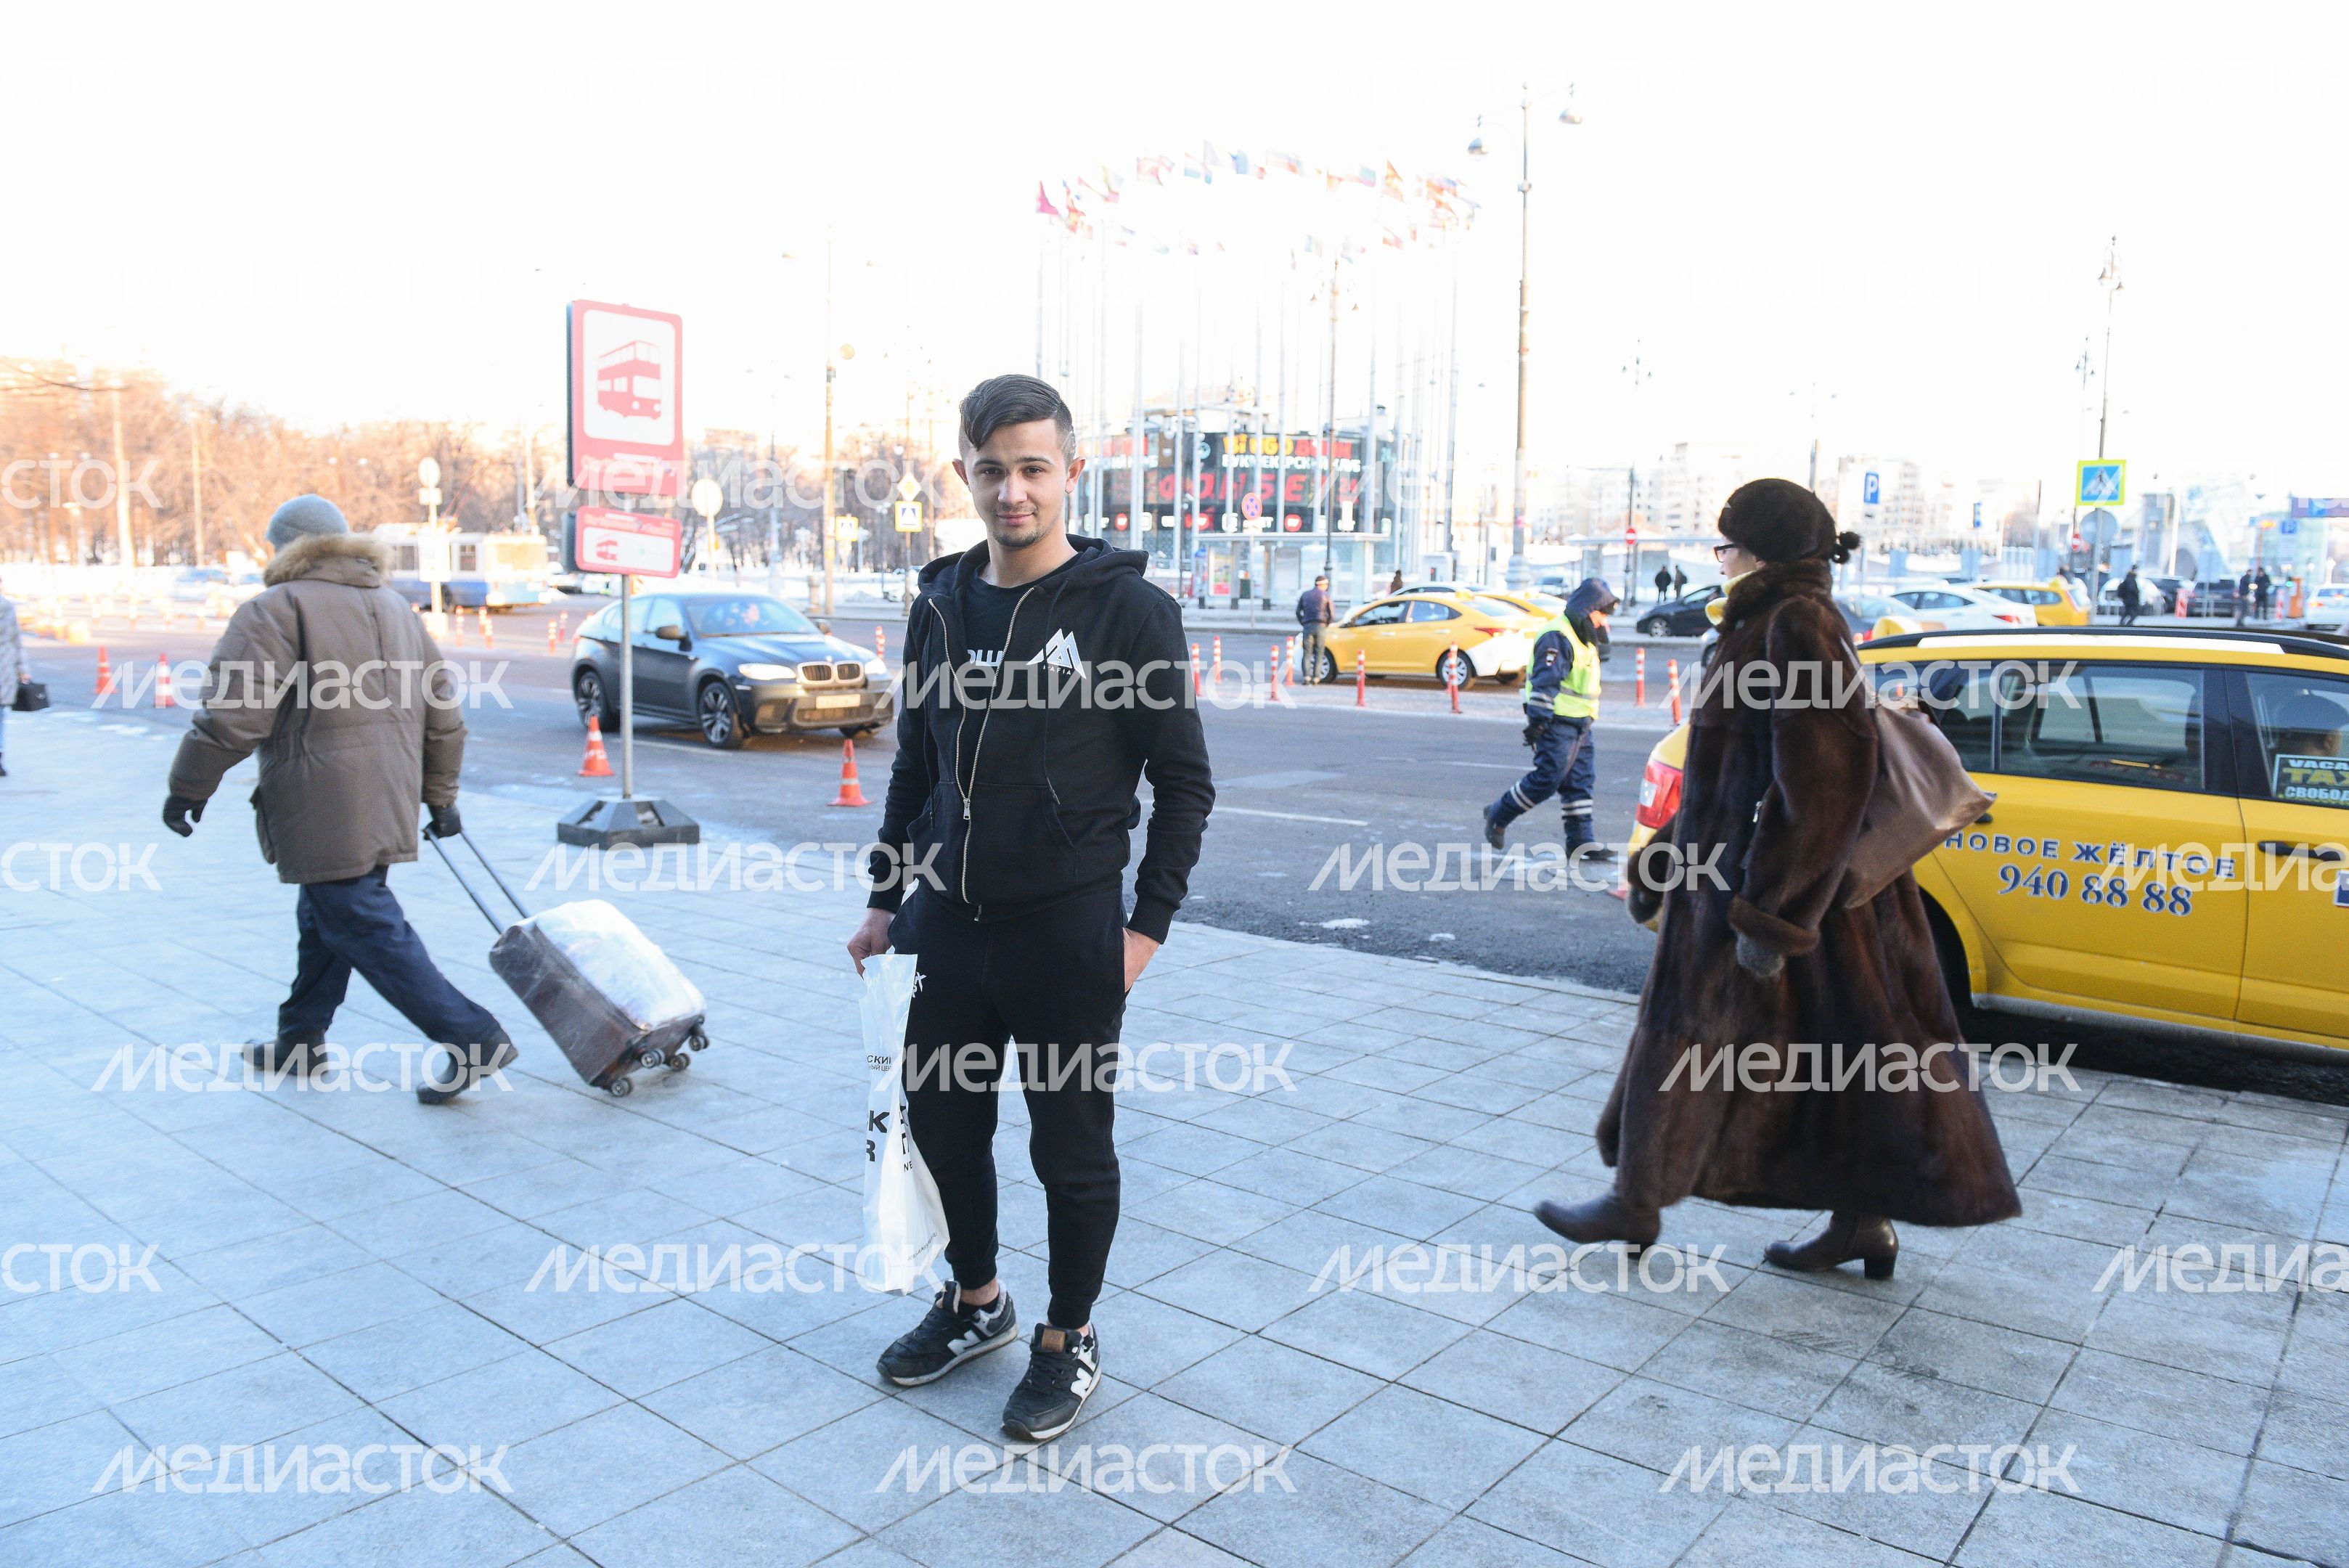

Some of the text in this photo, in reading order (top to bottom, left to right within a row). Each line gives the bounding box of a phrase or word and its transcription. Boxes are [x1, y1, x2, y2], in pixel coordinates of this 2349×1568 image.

[1945, 831, 2236, 879] НОВОЕ ЖЁЛТОЕ
[1998, 862, 2194, 918] 940 88 88
